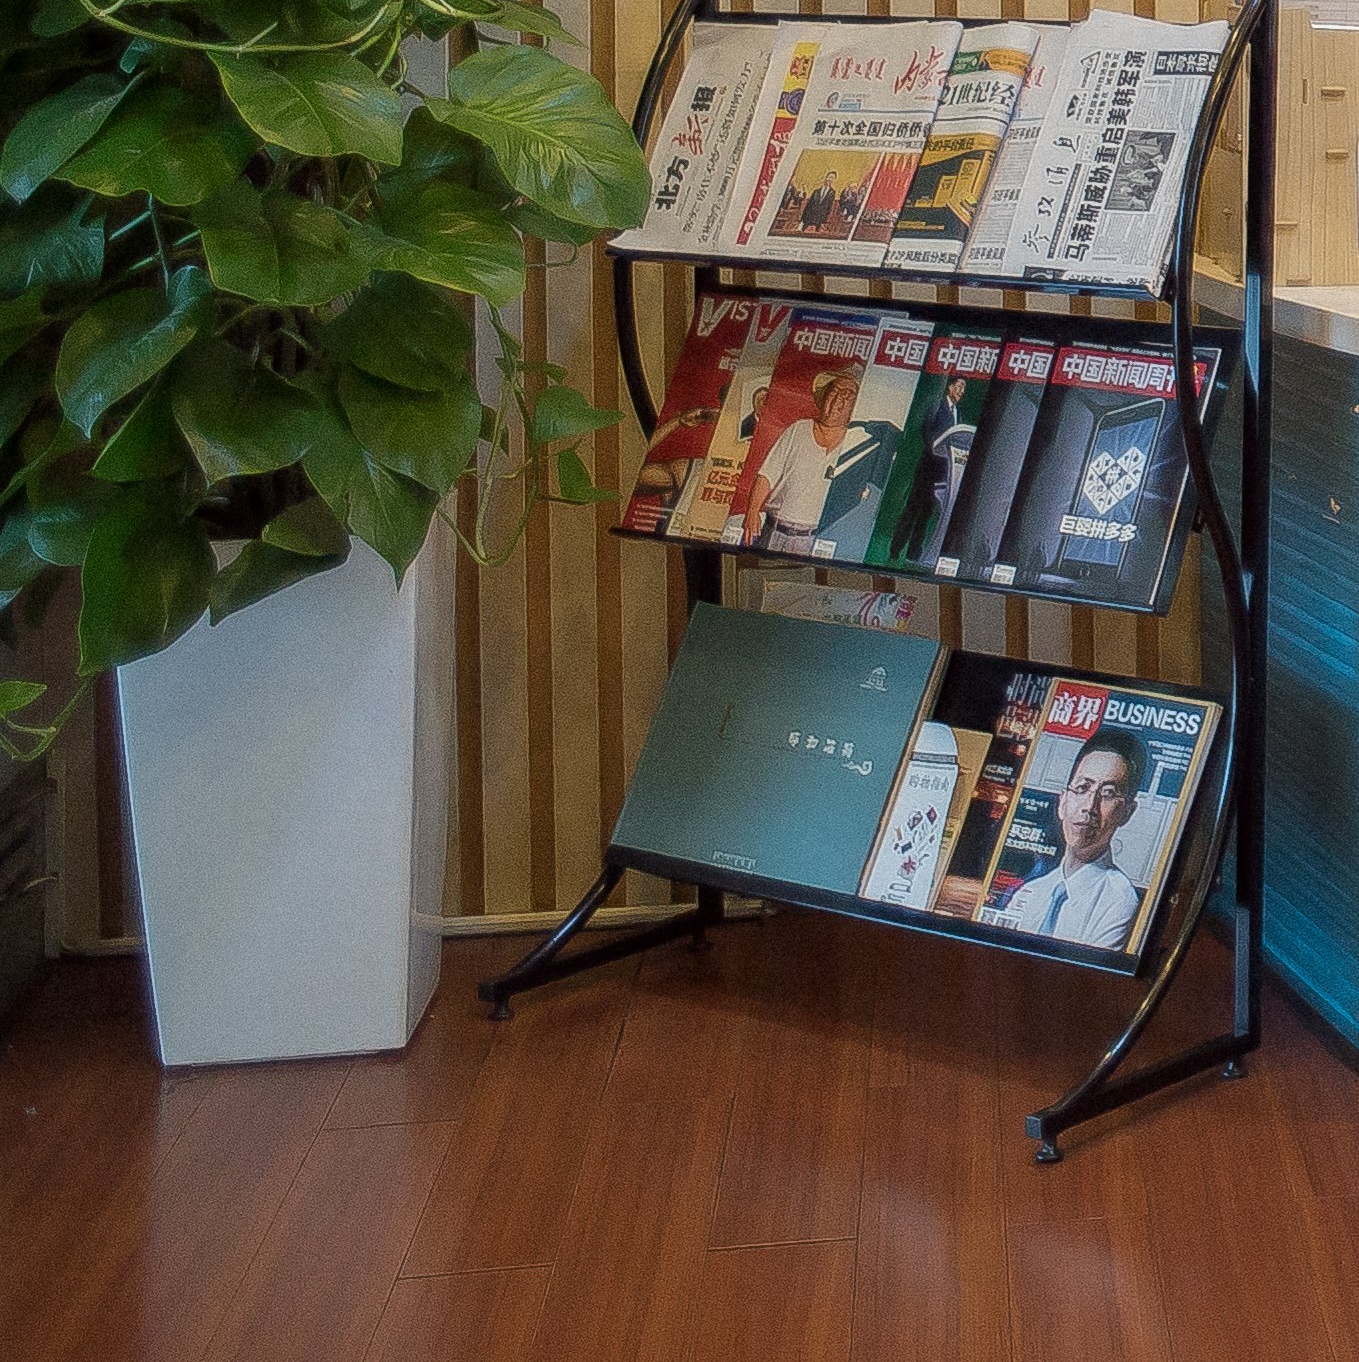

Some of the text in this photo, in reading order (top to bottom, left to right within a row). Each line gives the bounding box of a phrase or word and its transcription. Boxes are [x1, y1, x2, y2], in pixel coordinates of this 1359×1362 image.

[697, 297, 756, 336] VIS
[794, 326, 873, 360] 中国新闻
[885, 339, 930, 367] 中国
[1008, 350, 1052, 378] 中国
[1049, 691, 1102, 730] 商界
[1104, 699, 1201, 735] BUSINESS
